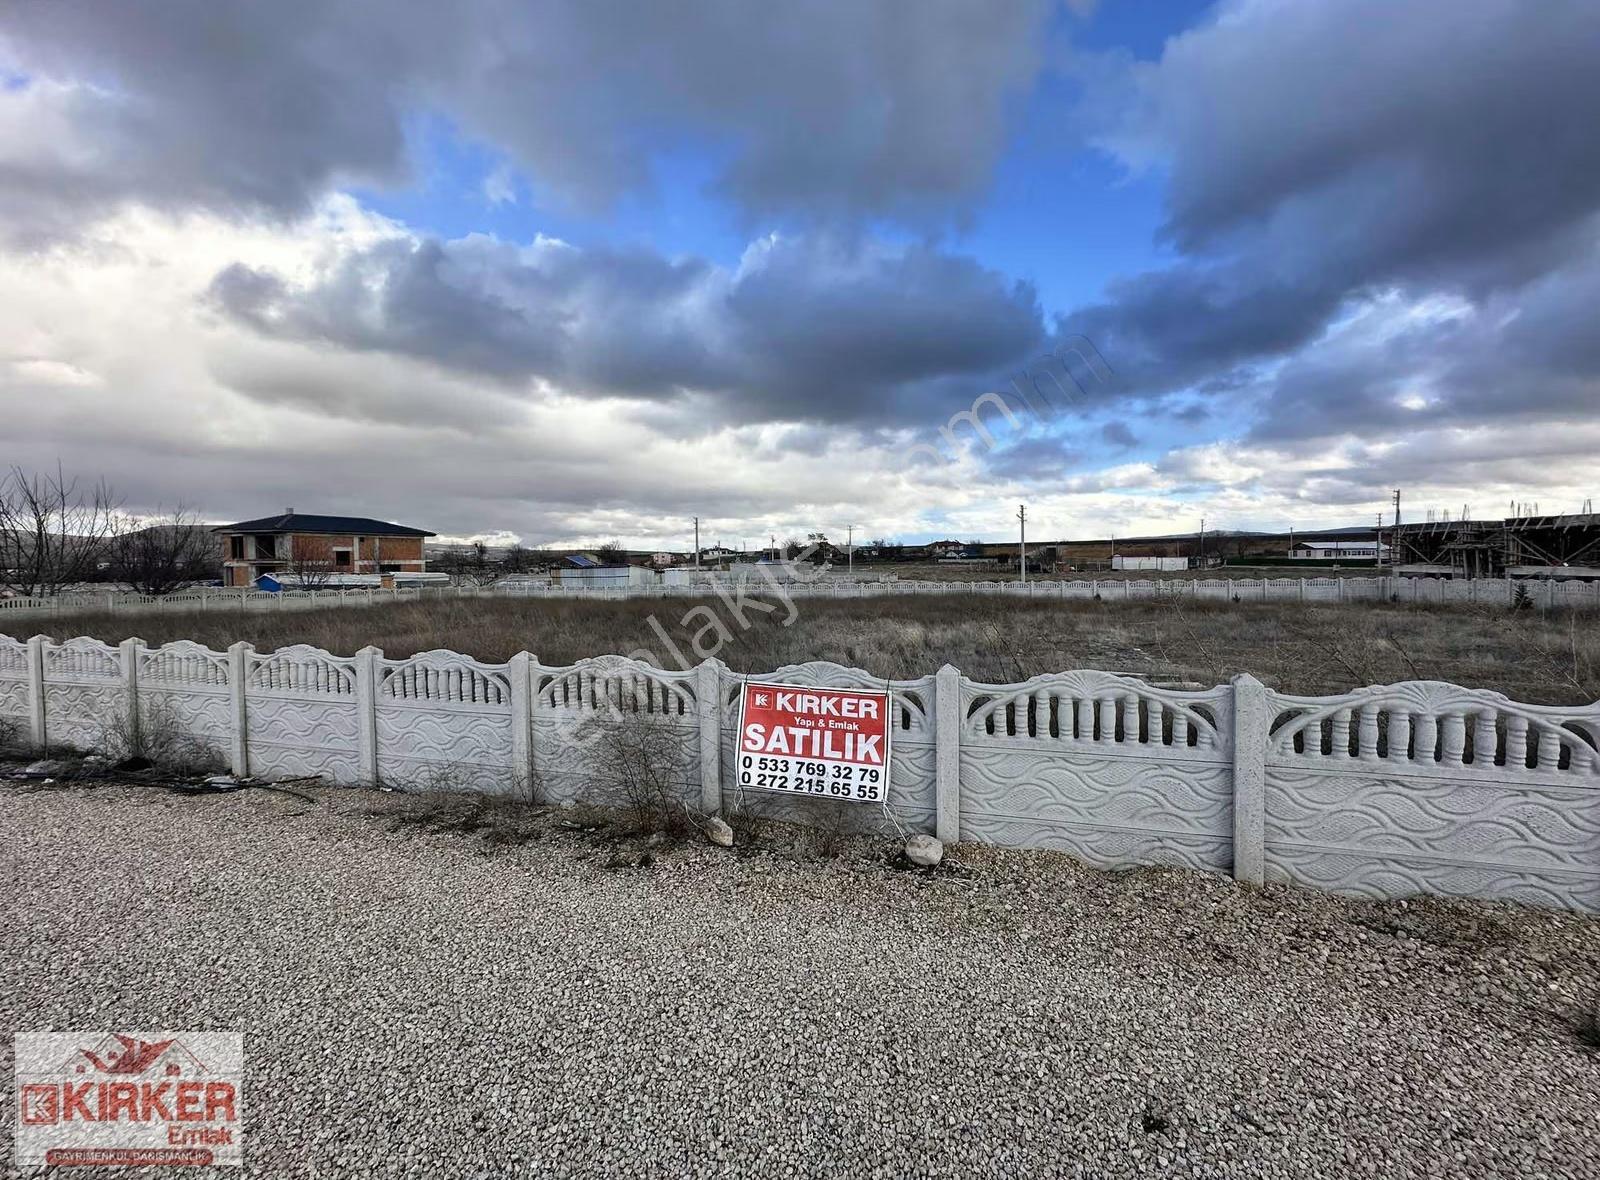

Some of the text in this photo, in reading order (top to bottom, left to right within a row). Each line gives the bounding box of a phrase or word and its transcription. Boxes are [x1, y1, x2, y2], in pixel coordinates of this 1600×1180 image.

[776, 692, 878, 720] KIRKER
[818, 719, 825, 728] &
[828, 719, 859, 731] Emlak
[743, 723, 882, 763] SATILIK
[742, 756, 880, 783] 0 533 769 32 79
[741, 771, 878, 800] 0 272 215 65 55
